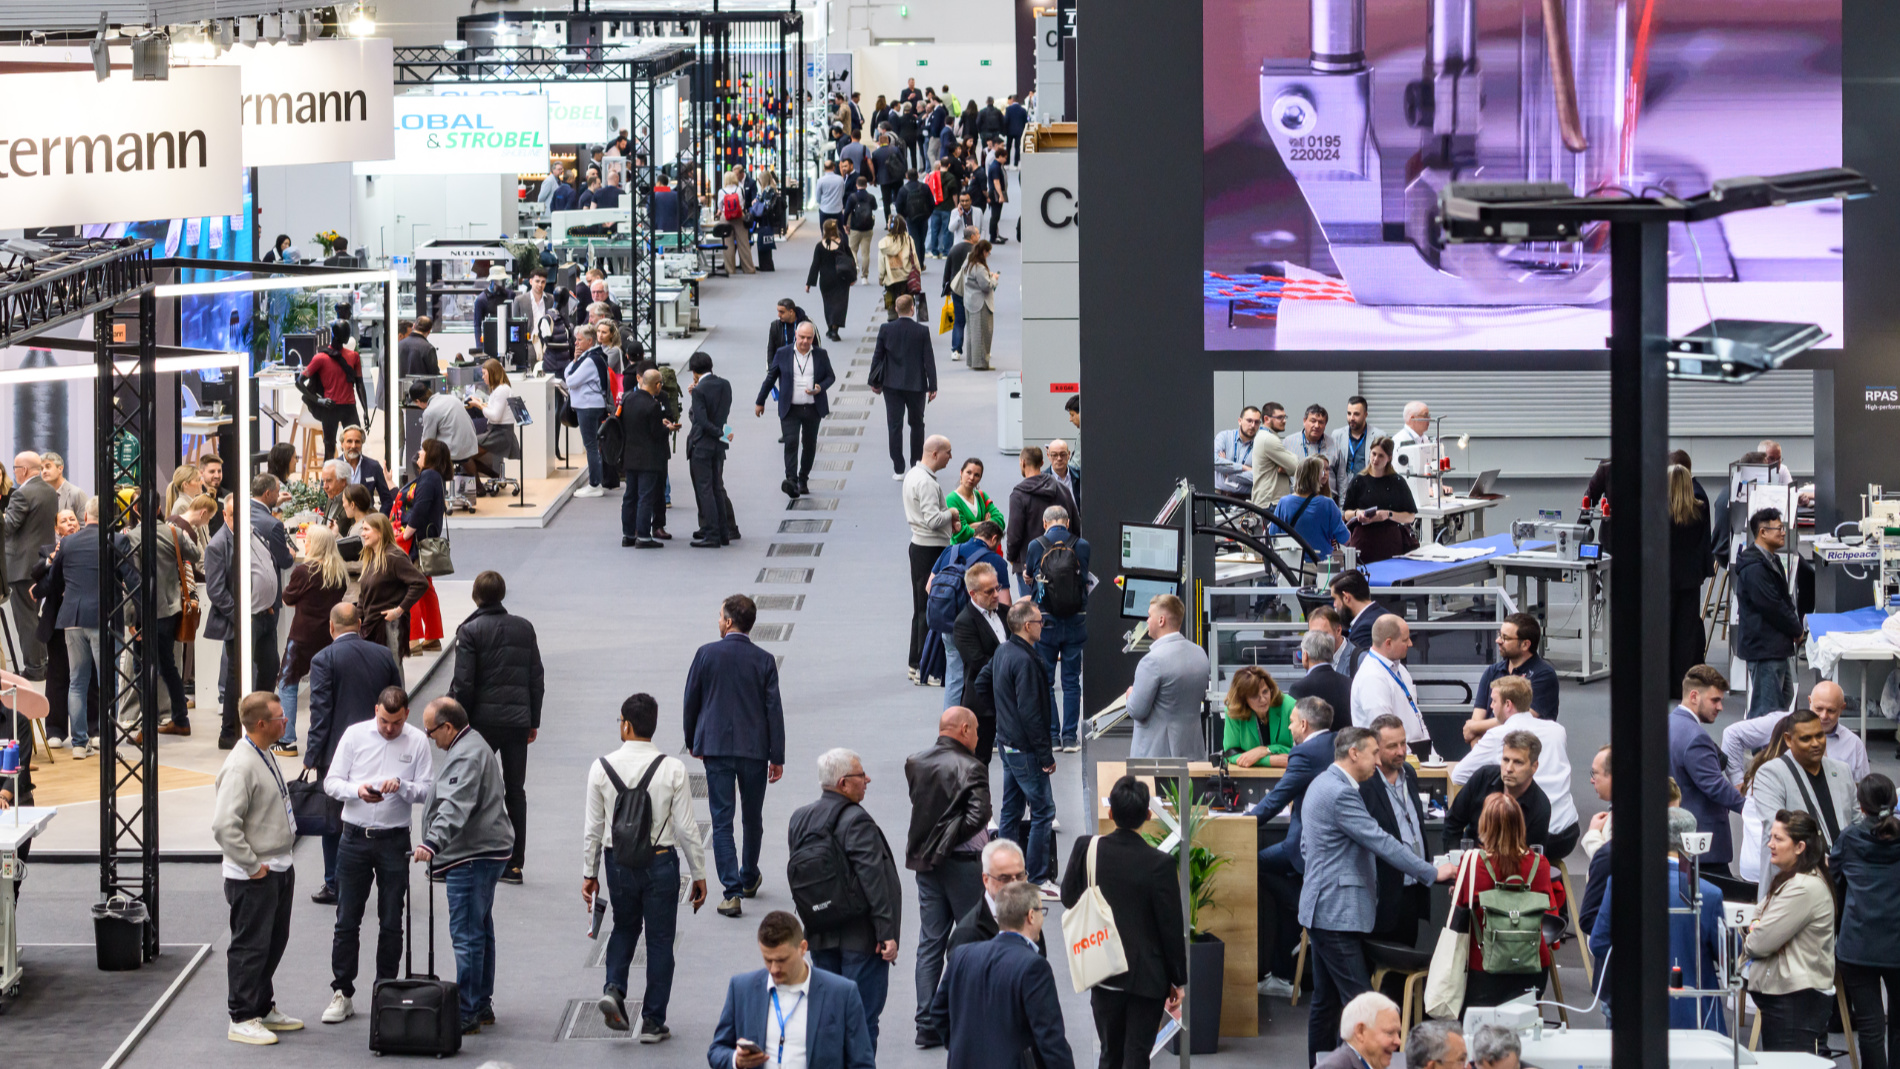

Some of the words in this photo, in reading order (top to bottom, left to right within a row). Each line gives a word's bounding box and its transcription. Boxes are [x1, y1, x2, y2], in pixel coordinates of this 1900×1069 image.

[394, 113, 495, 130] OBAL
[426, 133, 441, 149] &
[445, 131, 544, 149] STROBEL
[1307, 135, 1341, 148] 0195
[1290, 148, 1341, 161] 220024
[1040, 187, 1078, 229] C
[1865, 390, 1899, 402] RPAS
[1827, 550, 1878, 560] Richpeace
[1699, 837, 1706, 851] 6
[1735, 909, 1744, 924] 5
[1073, 925, 1109, 955] macpi
